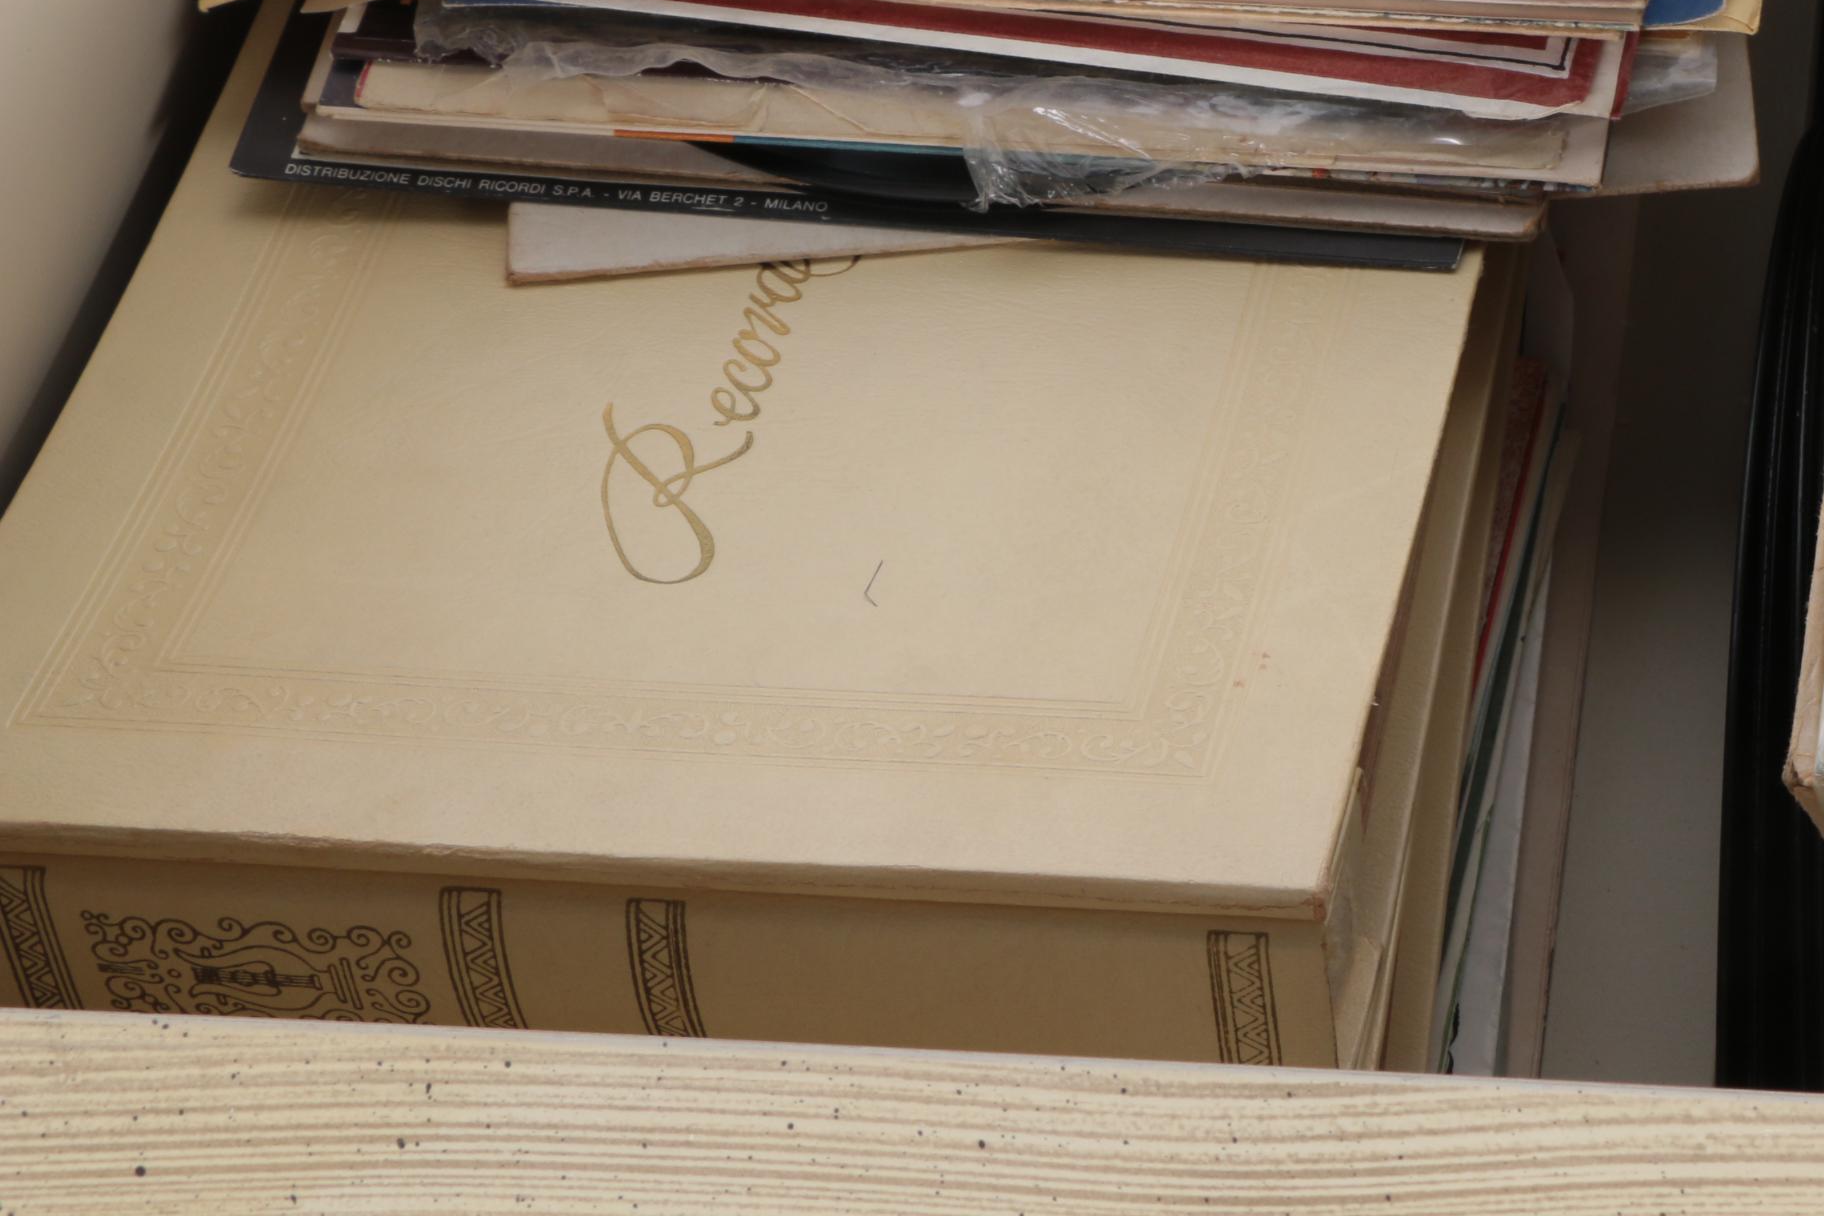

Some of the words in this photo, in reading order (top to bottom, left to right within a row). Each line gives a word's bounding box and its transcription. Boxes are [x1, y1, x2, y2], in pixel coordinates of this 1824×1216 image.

[285, 162, 410, 186] DISTRIBUZIONE
[416, 173, 472, 190] DISCHI
[478, 178, 547, 196] RICORDI
[552, 184, 596, 200] S.P.A.
[617, 189, 643, 203] VIA
[648, 191, 729, 208] BERCHET
[733, 196, 745, 208] 2
[764, 198, 829, 214] MILANO
[600, 253, 862, 585] Record
